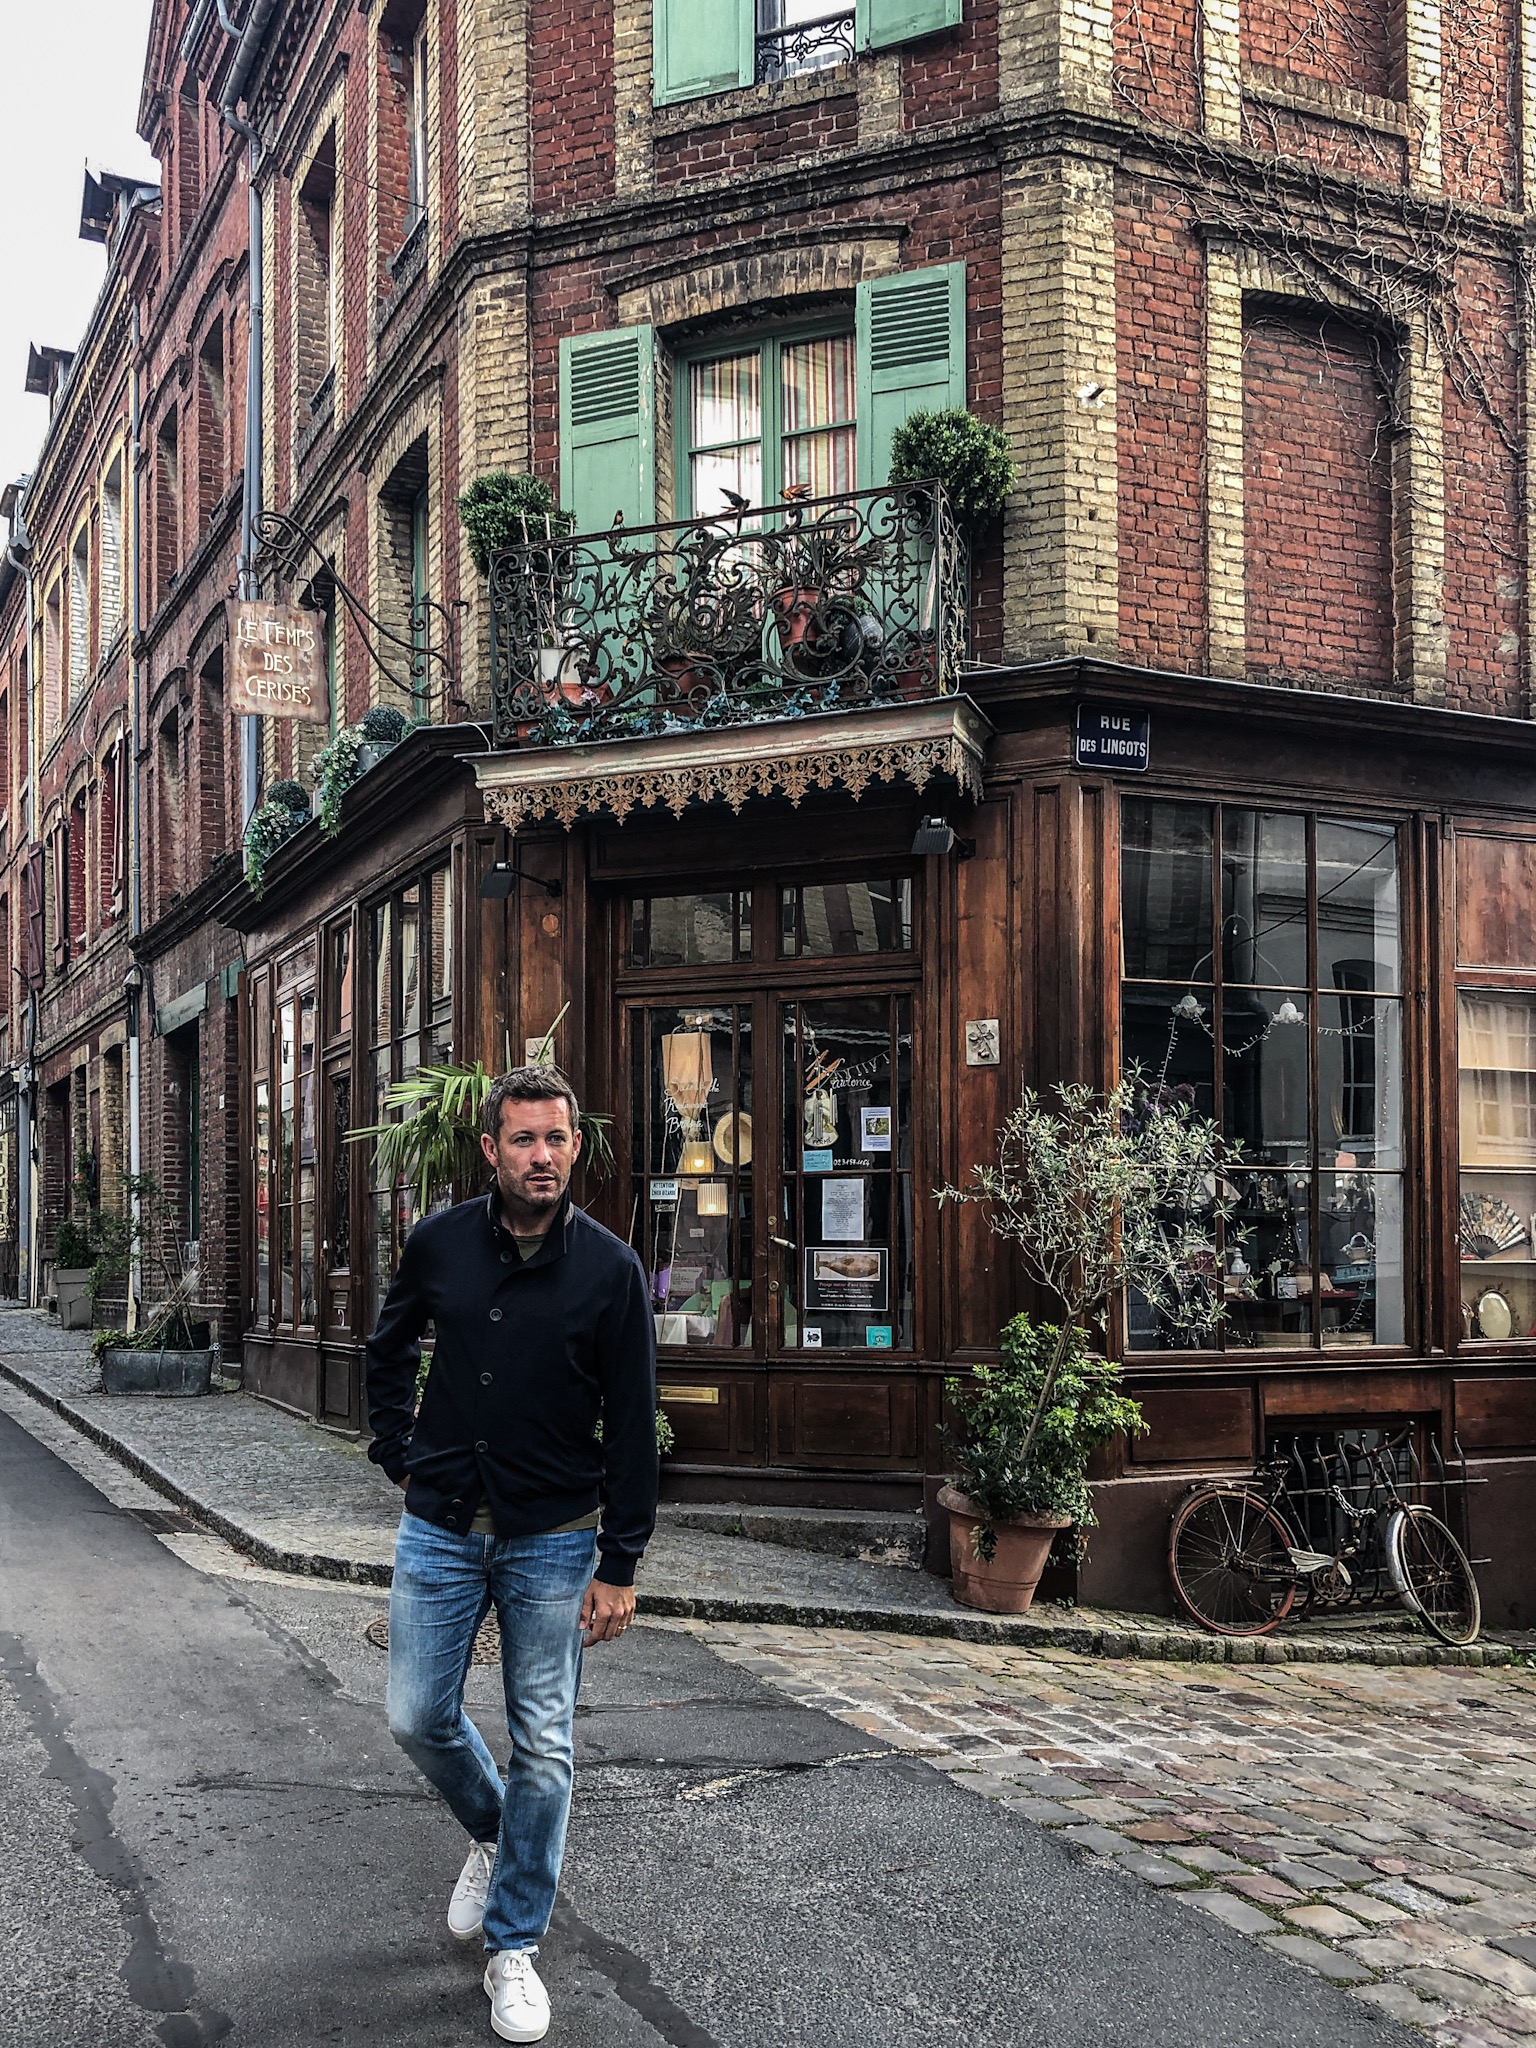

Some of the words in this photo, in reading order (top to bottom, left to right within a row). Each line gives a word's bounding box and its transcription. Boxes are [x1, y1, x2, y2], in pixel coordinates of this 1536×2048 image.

[236, 618, 258, 643] LE
[262, 621, 315, 652] TEMPS
[263, 652, 293, 675] DES
[245, 675, 311, 705] CERISES
[1100, 715, 1131, 731] RUE
[1080, 739, 1096, 752] DES
[1101, 738, 1146, 757] LINGOTS
